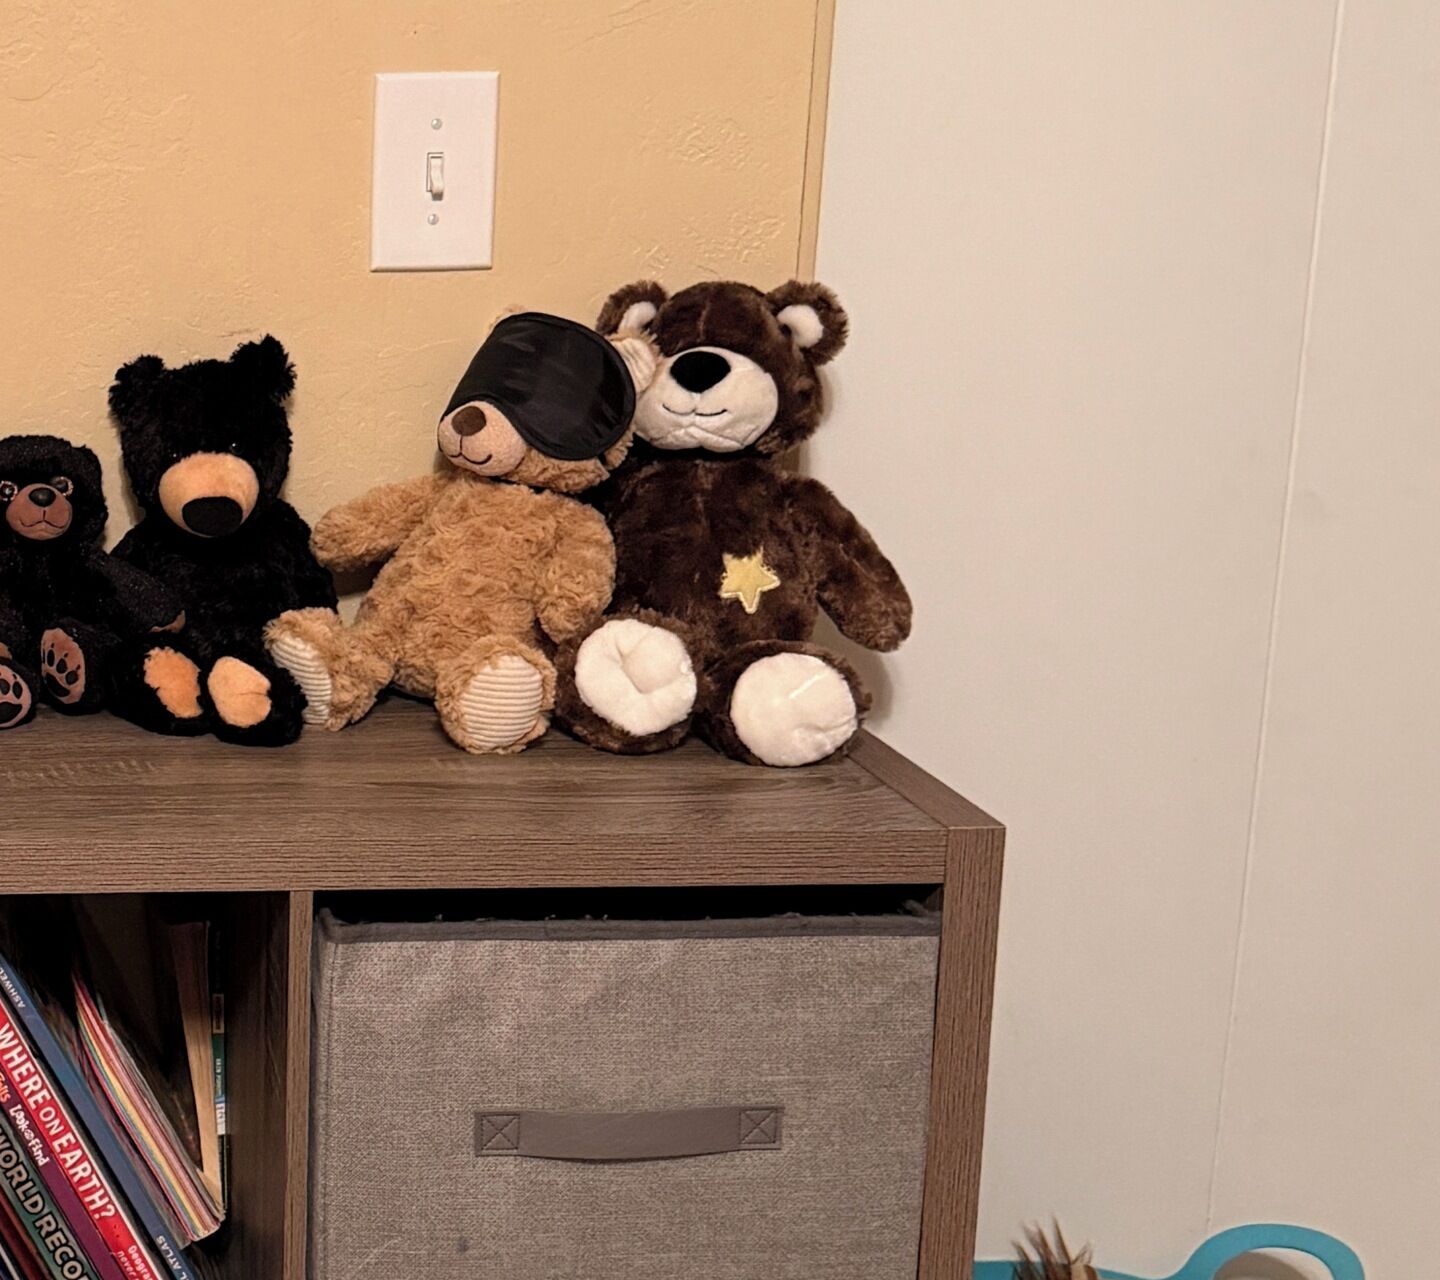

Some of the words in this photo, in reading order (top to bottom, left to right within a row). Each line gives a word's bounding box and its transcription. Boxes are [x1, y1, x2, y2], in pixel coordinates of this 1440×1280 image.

[40, 1106, 65, 1136] ON
[52, 1132, 116, 1220] EARTH?
[117, 1250, 137, 1280] never
[156, 1235, 182, 1271] ATLAS
